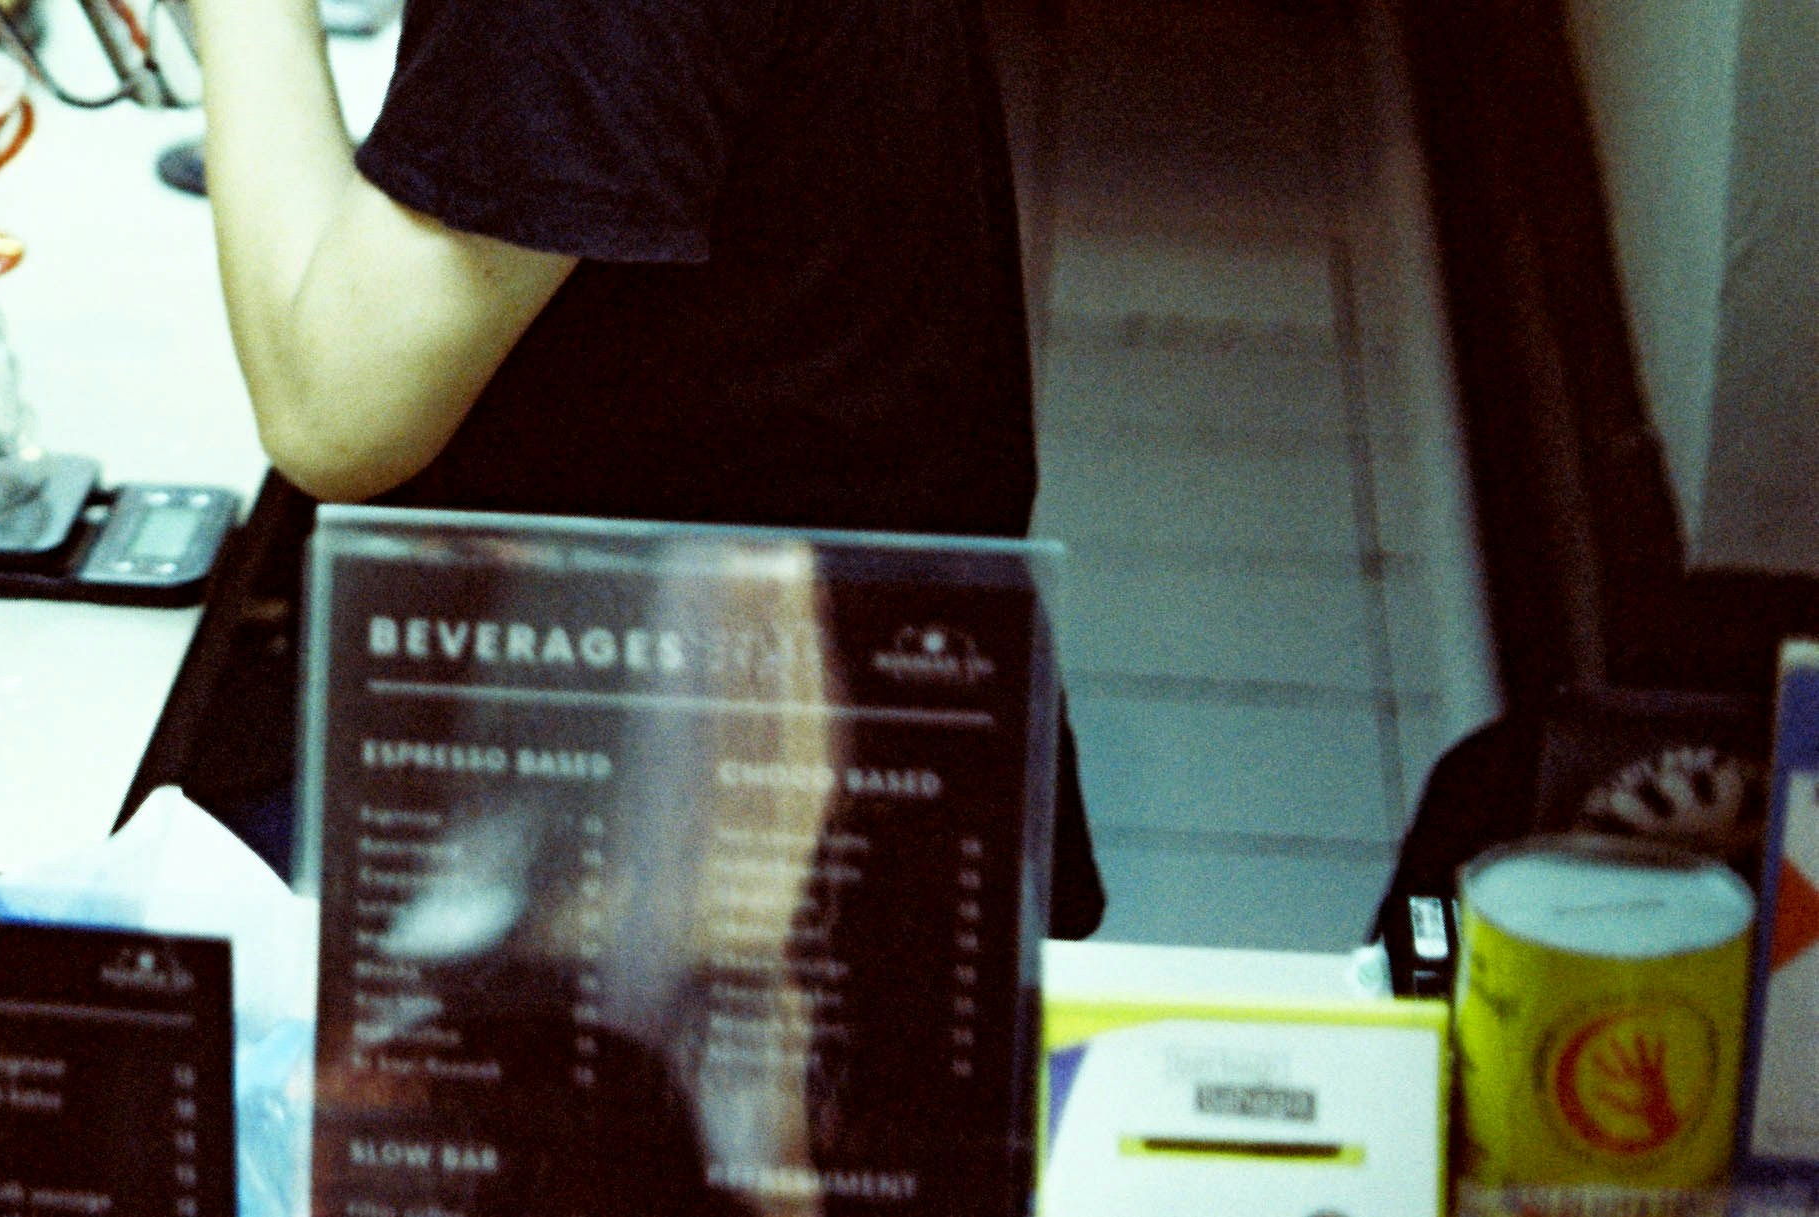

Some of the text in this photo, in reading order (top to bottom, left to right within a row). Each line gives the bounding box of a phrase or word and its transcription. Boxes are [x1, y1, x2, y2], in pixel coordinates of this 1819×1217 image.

[368, 615, 686, 671] BEVERAGES
[362, 739, 613, 779] ESPRESSO BASED
[846, 767, 943, 798] BASED
